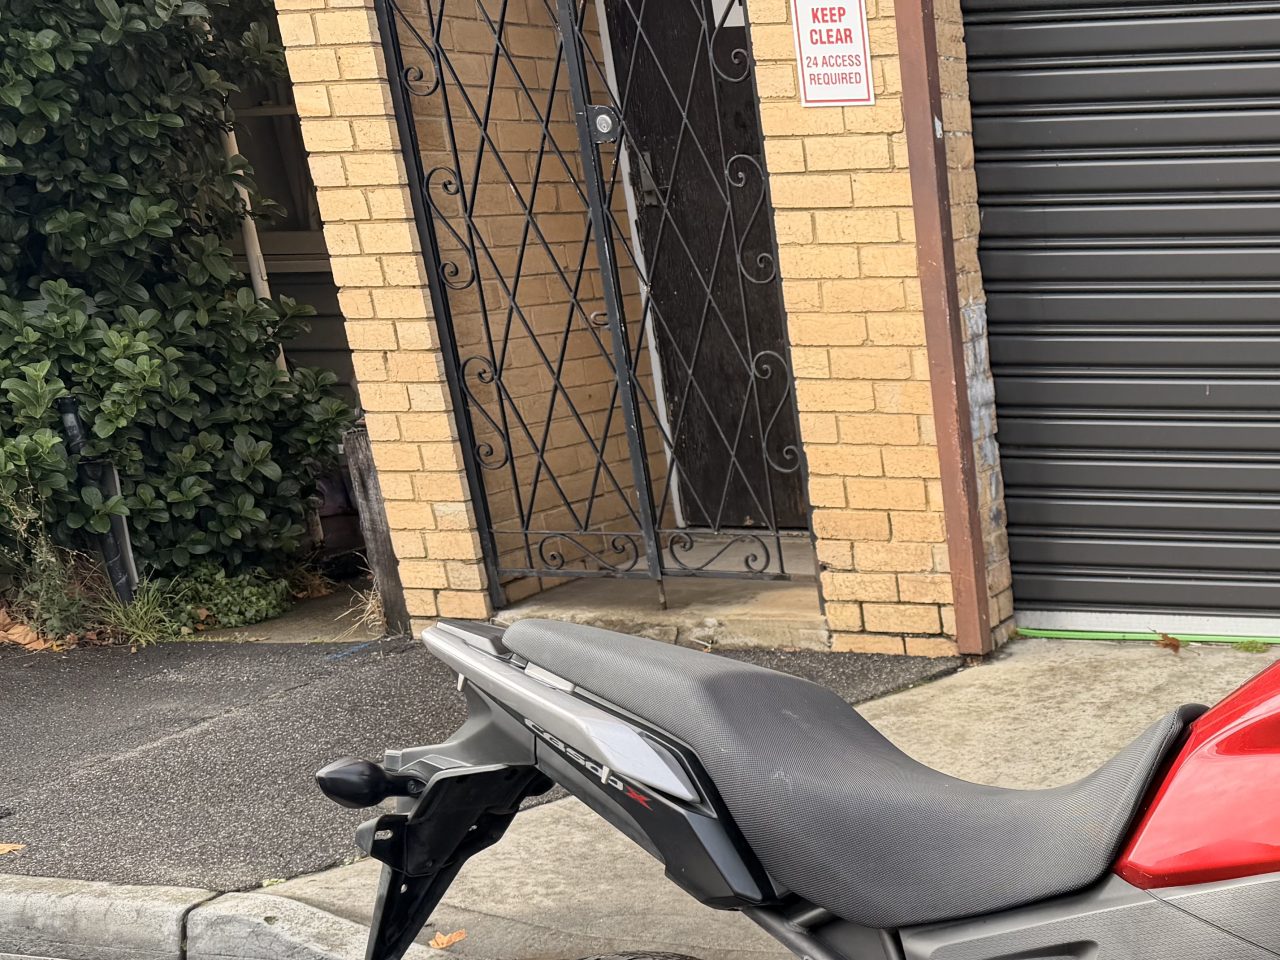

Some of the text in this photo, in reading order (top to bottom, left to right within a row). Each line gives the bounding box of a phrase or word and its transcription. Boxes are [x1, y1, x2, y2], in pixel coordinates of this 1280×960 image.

[811, 7, 846, 24] KEEP
[809, 28, 853, 45] CLEAR
[806, 54, 862, 68] 24 ACCESS
[809, 72, 862, 86] REQUIRED
